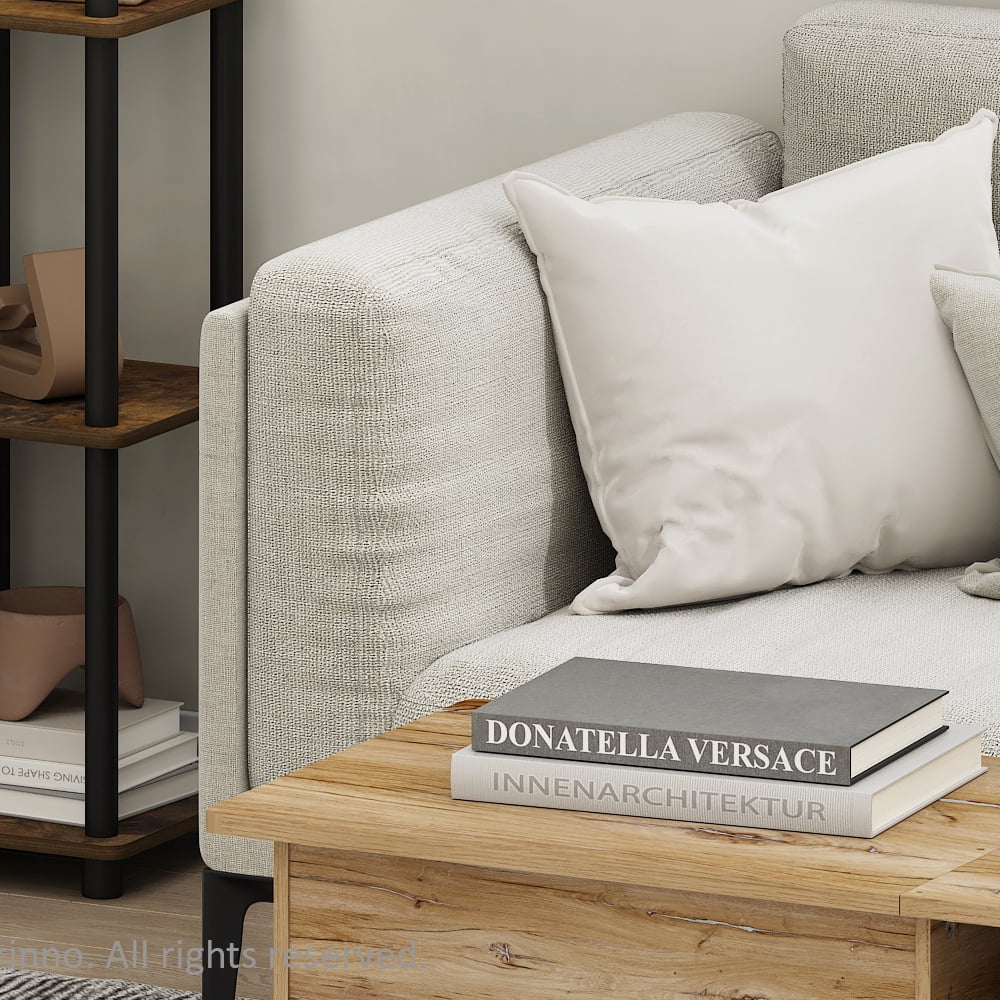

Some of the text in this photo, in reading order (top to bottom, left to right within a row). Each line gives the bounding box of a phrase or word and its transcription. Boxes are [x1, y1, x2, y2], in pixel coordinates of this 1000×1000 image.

[486, 719, 837, 776] DONATELLA VERSACE
[1, 765, 15, 776] TO
[18, 767, 51, 780] SHAPE
[493, 771, 827, 821] INNENARCHITEKTUR
